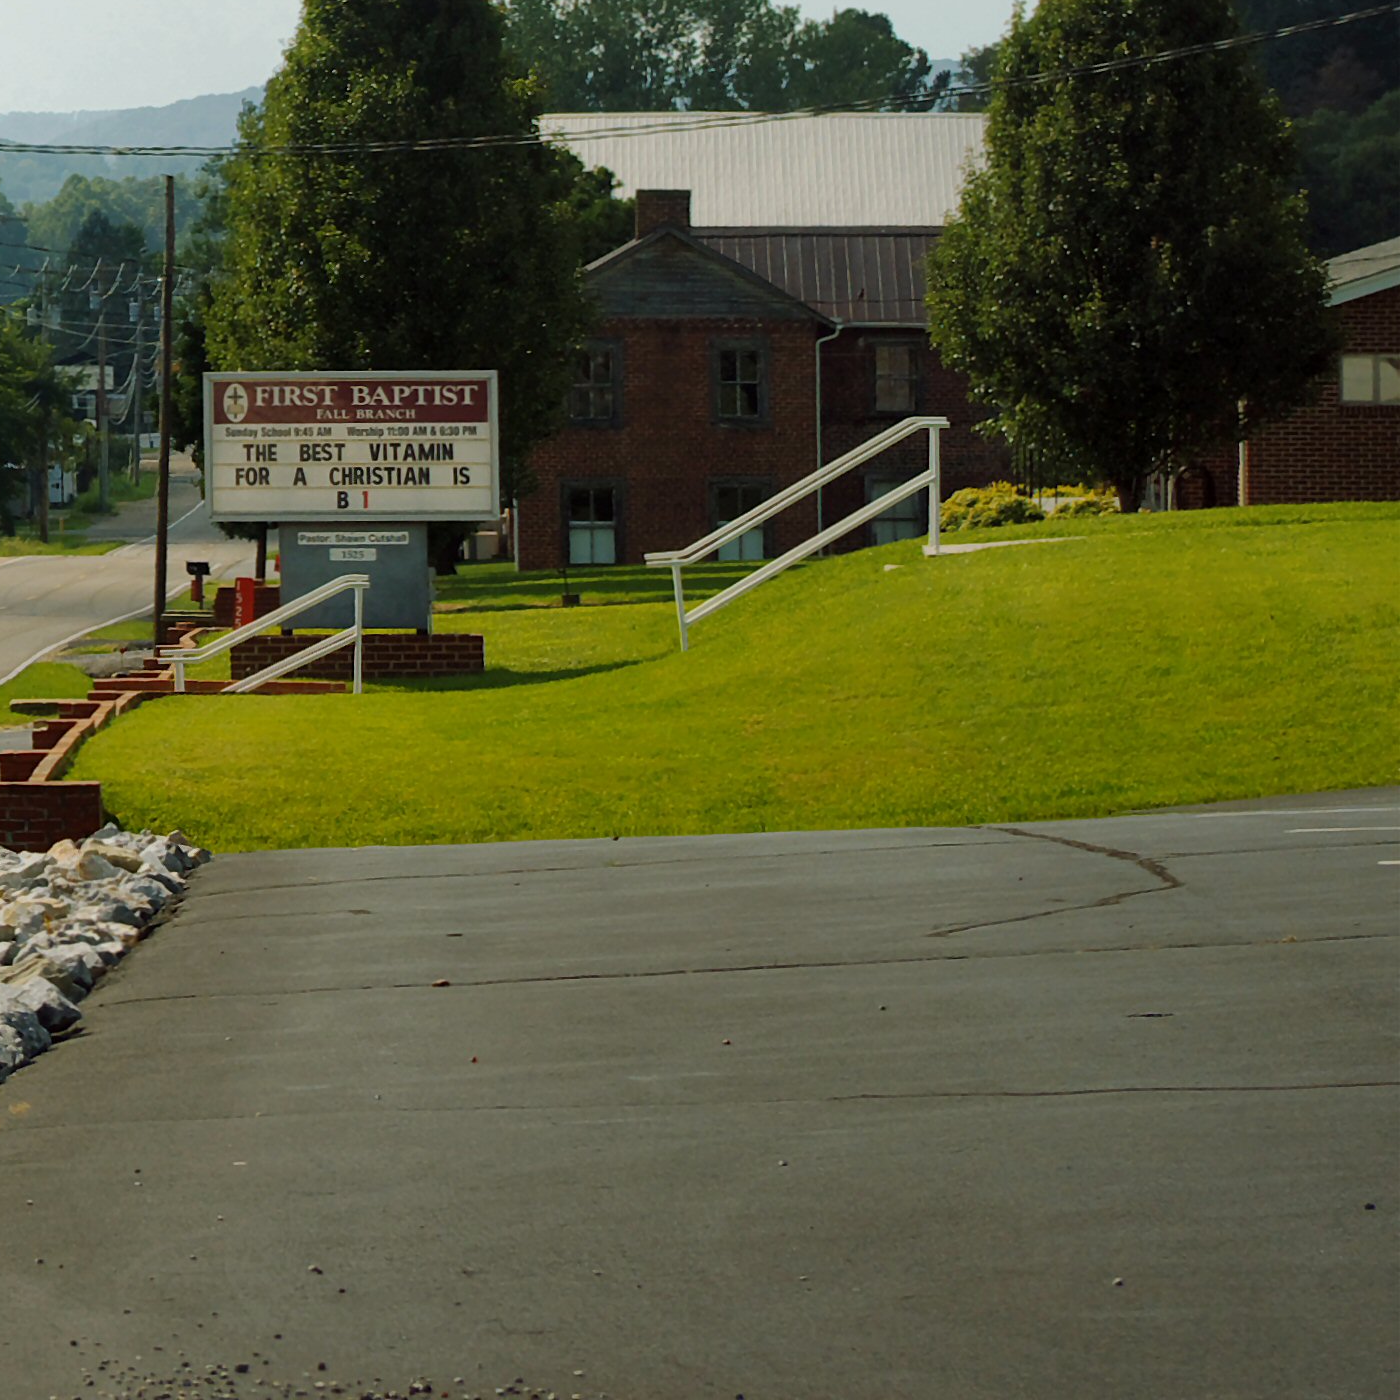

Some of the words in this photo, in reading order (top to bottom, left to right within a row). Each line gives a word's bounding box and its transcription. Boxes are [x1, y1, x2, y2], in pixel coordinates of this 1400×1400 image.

[255, 385, 338, 407] FIRST
[350, 385, 479, 406] BAPTIST
[316, 408, 350, 420] FALL
[356, 408, 416, 419] BRANCH
[225, 426, 258, 439] Sunday
[260, 426, 292, 437] School
[316, 426, 332, 437] AM
[346, 426, 384, 438] Worship
[412, 426, 428, 436] AM
[429, 426, 437, 436] &
[462, 425, 478, 436] PM
[243, 444, 278, 462] THE
[299, 443, 346, 462] BEST
[369, 443, 454, 462] VITAMIN
[235, 467, 270, 486] FOR
[293, 467, 307, 486] A
[329, 466, 431, 486] CHRISTIAN
[453, 467, 471, 486] IS
[336, 491, 349, 509] B
[362, 491, 369, 509] 1
